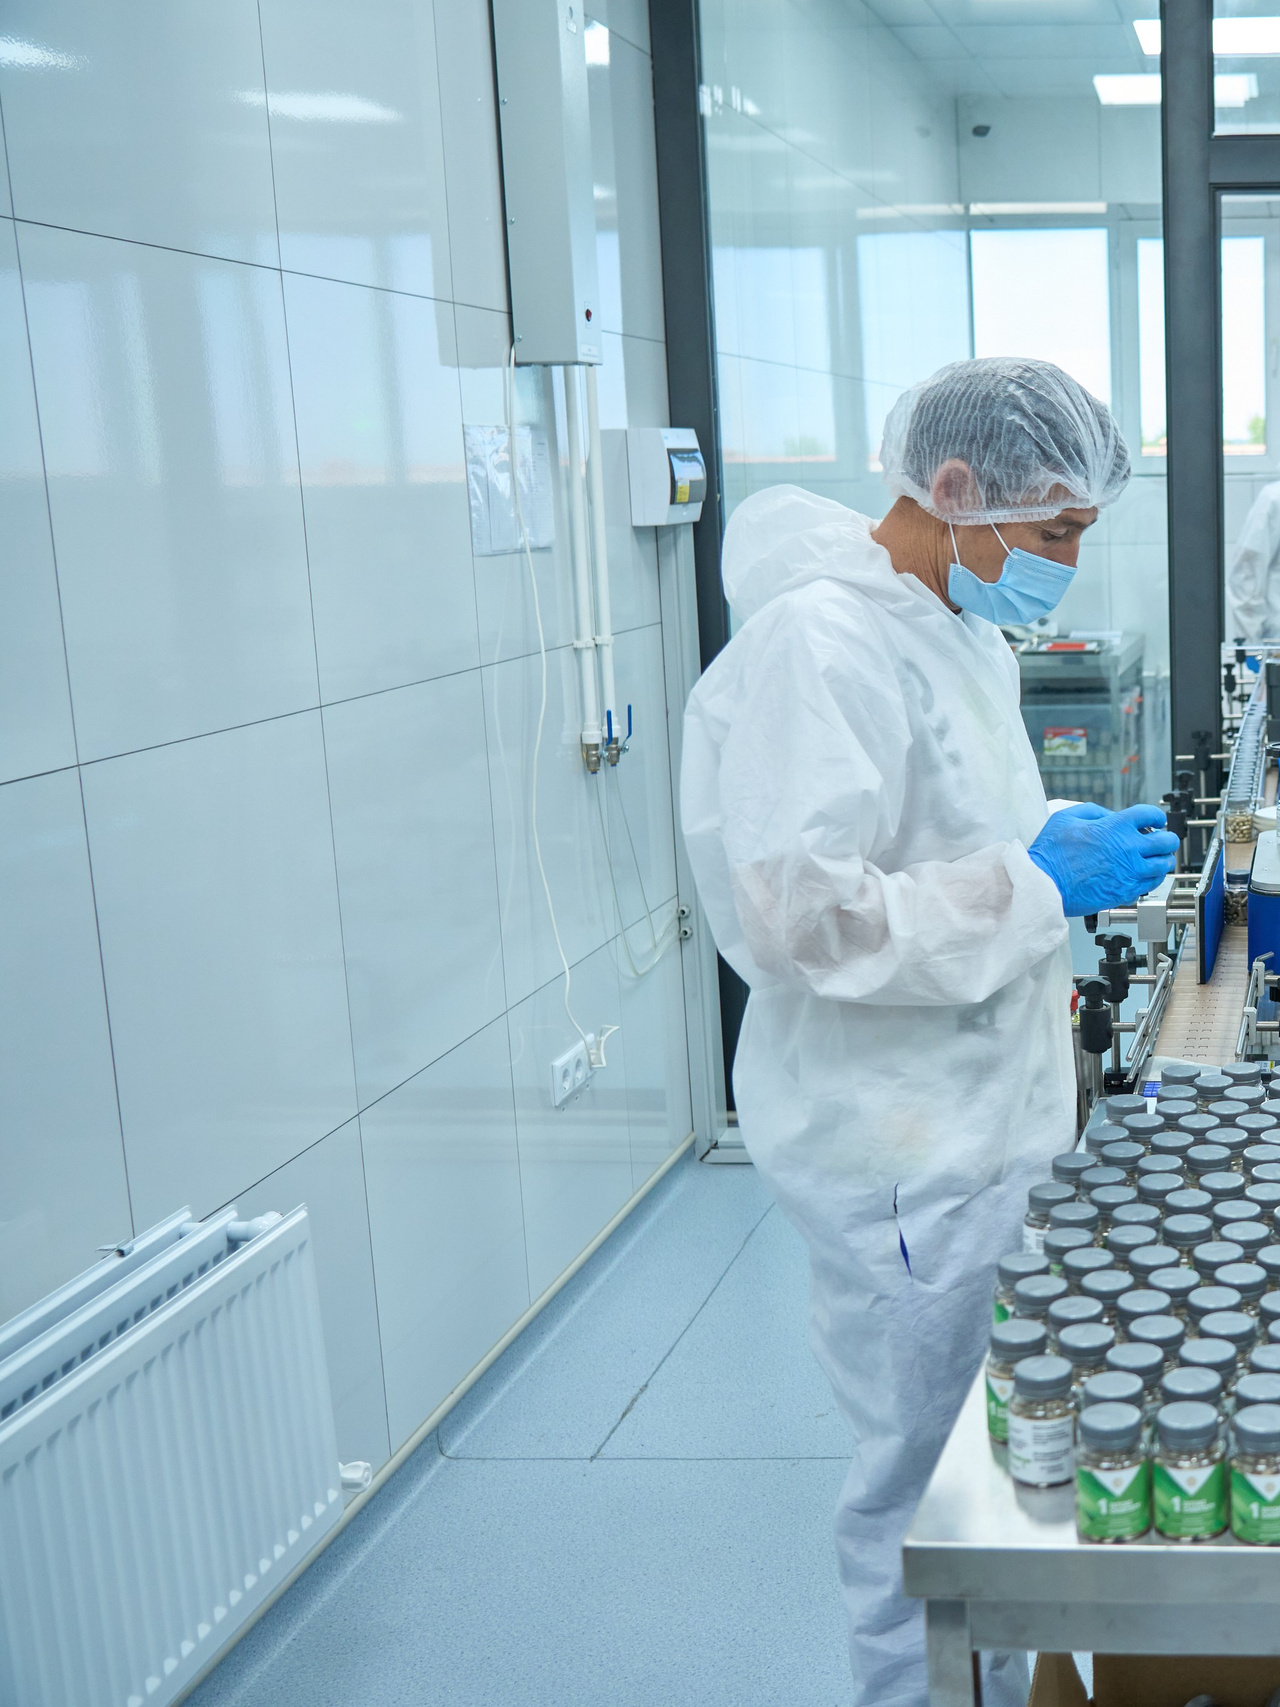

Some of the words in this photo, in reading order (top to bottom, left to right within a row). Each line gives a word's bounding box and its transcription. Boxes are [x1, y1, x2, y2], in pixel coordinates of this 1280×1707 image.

[1097, 1498, 1107, 1515] 1
[1171, 1496, 1181, 1513] 1
[1250, 1502, 1259, 1519] 1
